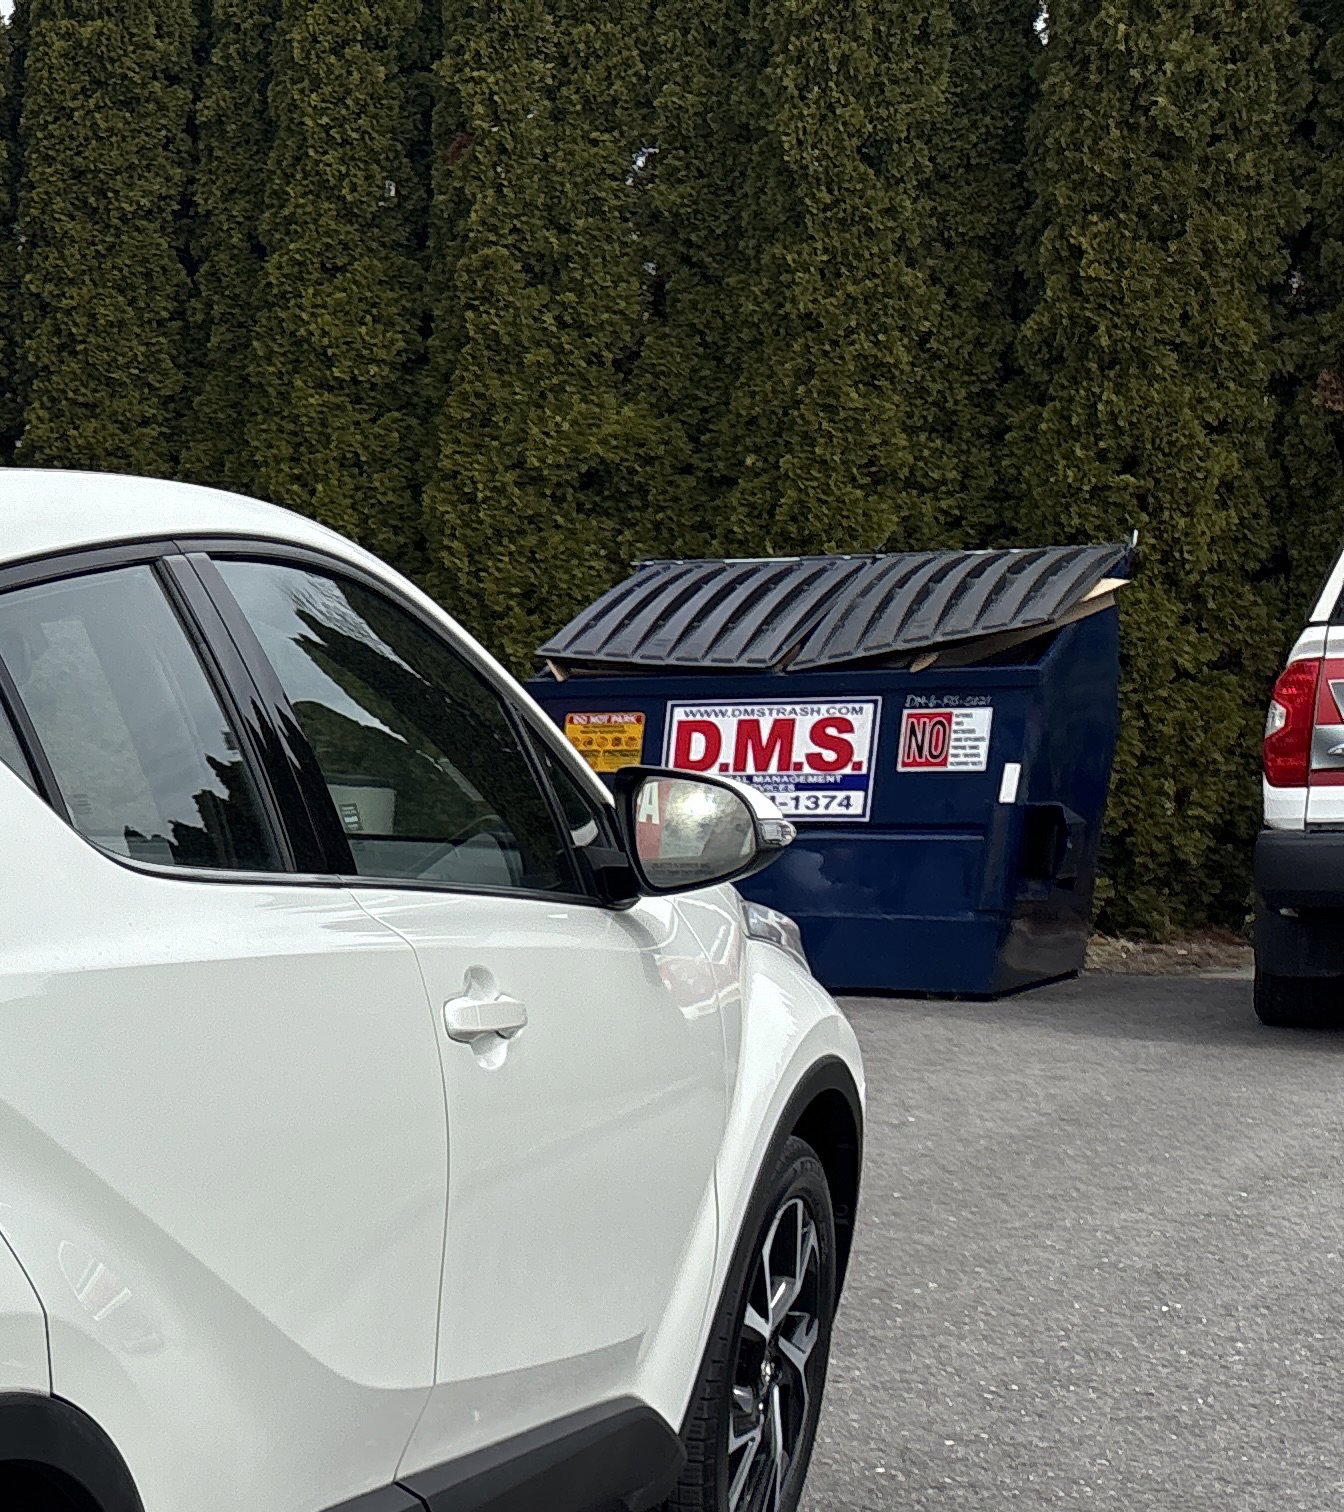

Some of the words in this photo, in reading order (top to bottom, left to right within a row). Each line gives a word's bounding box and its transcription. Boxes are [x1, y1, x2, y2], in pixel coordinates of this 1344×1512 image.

[683, 706, 863, 718] WWW.DMSTRASH.COM
[673, 716, 864, 772] D.M.S.
[904, 717, 950, 763] NO
[752, 774, 843, 784] MANAGEMENT
